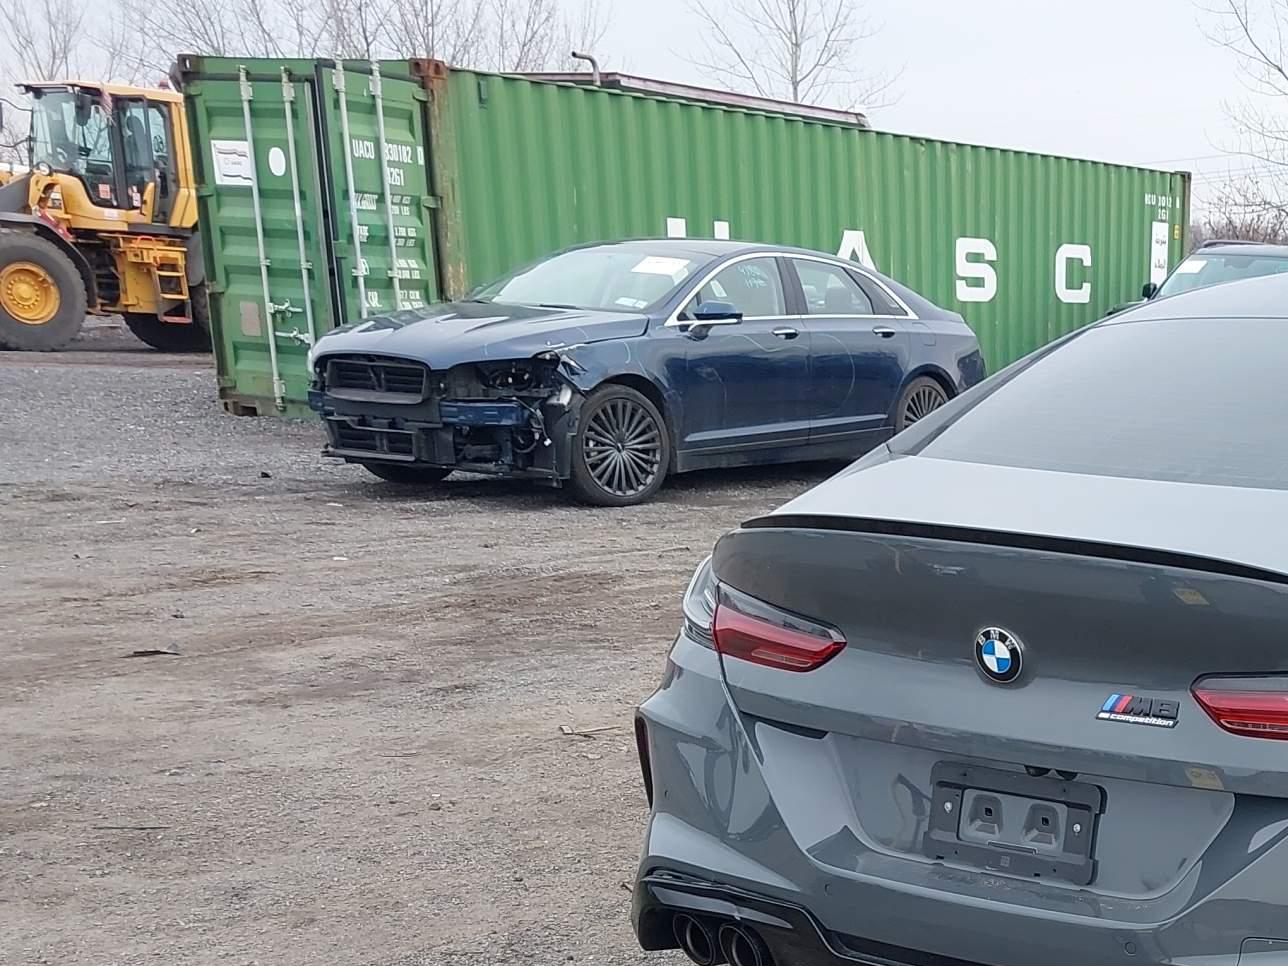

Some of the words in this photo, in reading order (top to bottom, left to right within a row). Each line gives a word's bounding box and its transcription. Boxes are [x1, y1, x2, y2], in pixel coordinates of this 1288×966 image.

[352, 138, 375, 159] UACU
[1119, 695, 1181, 720] M8
[1109, 713, 1174, 727] competition
